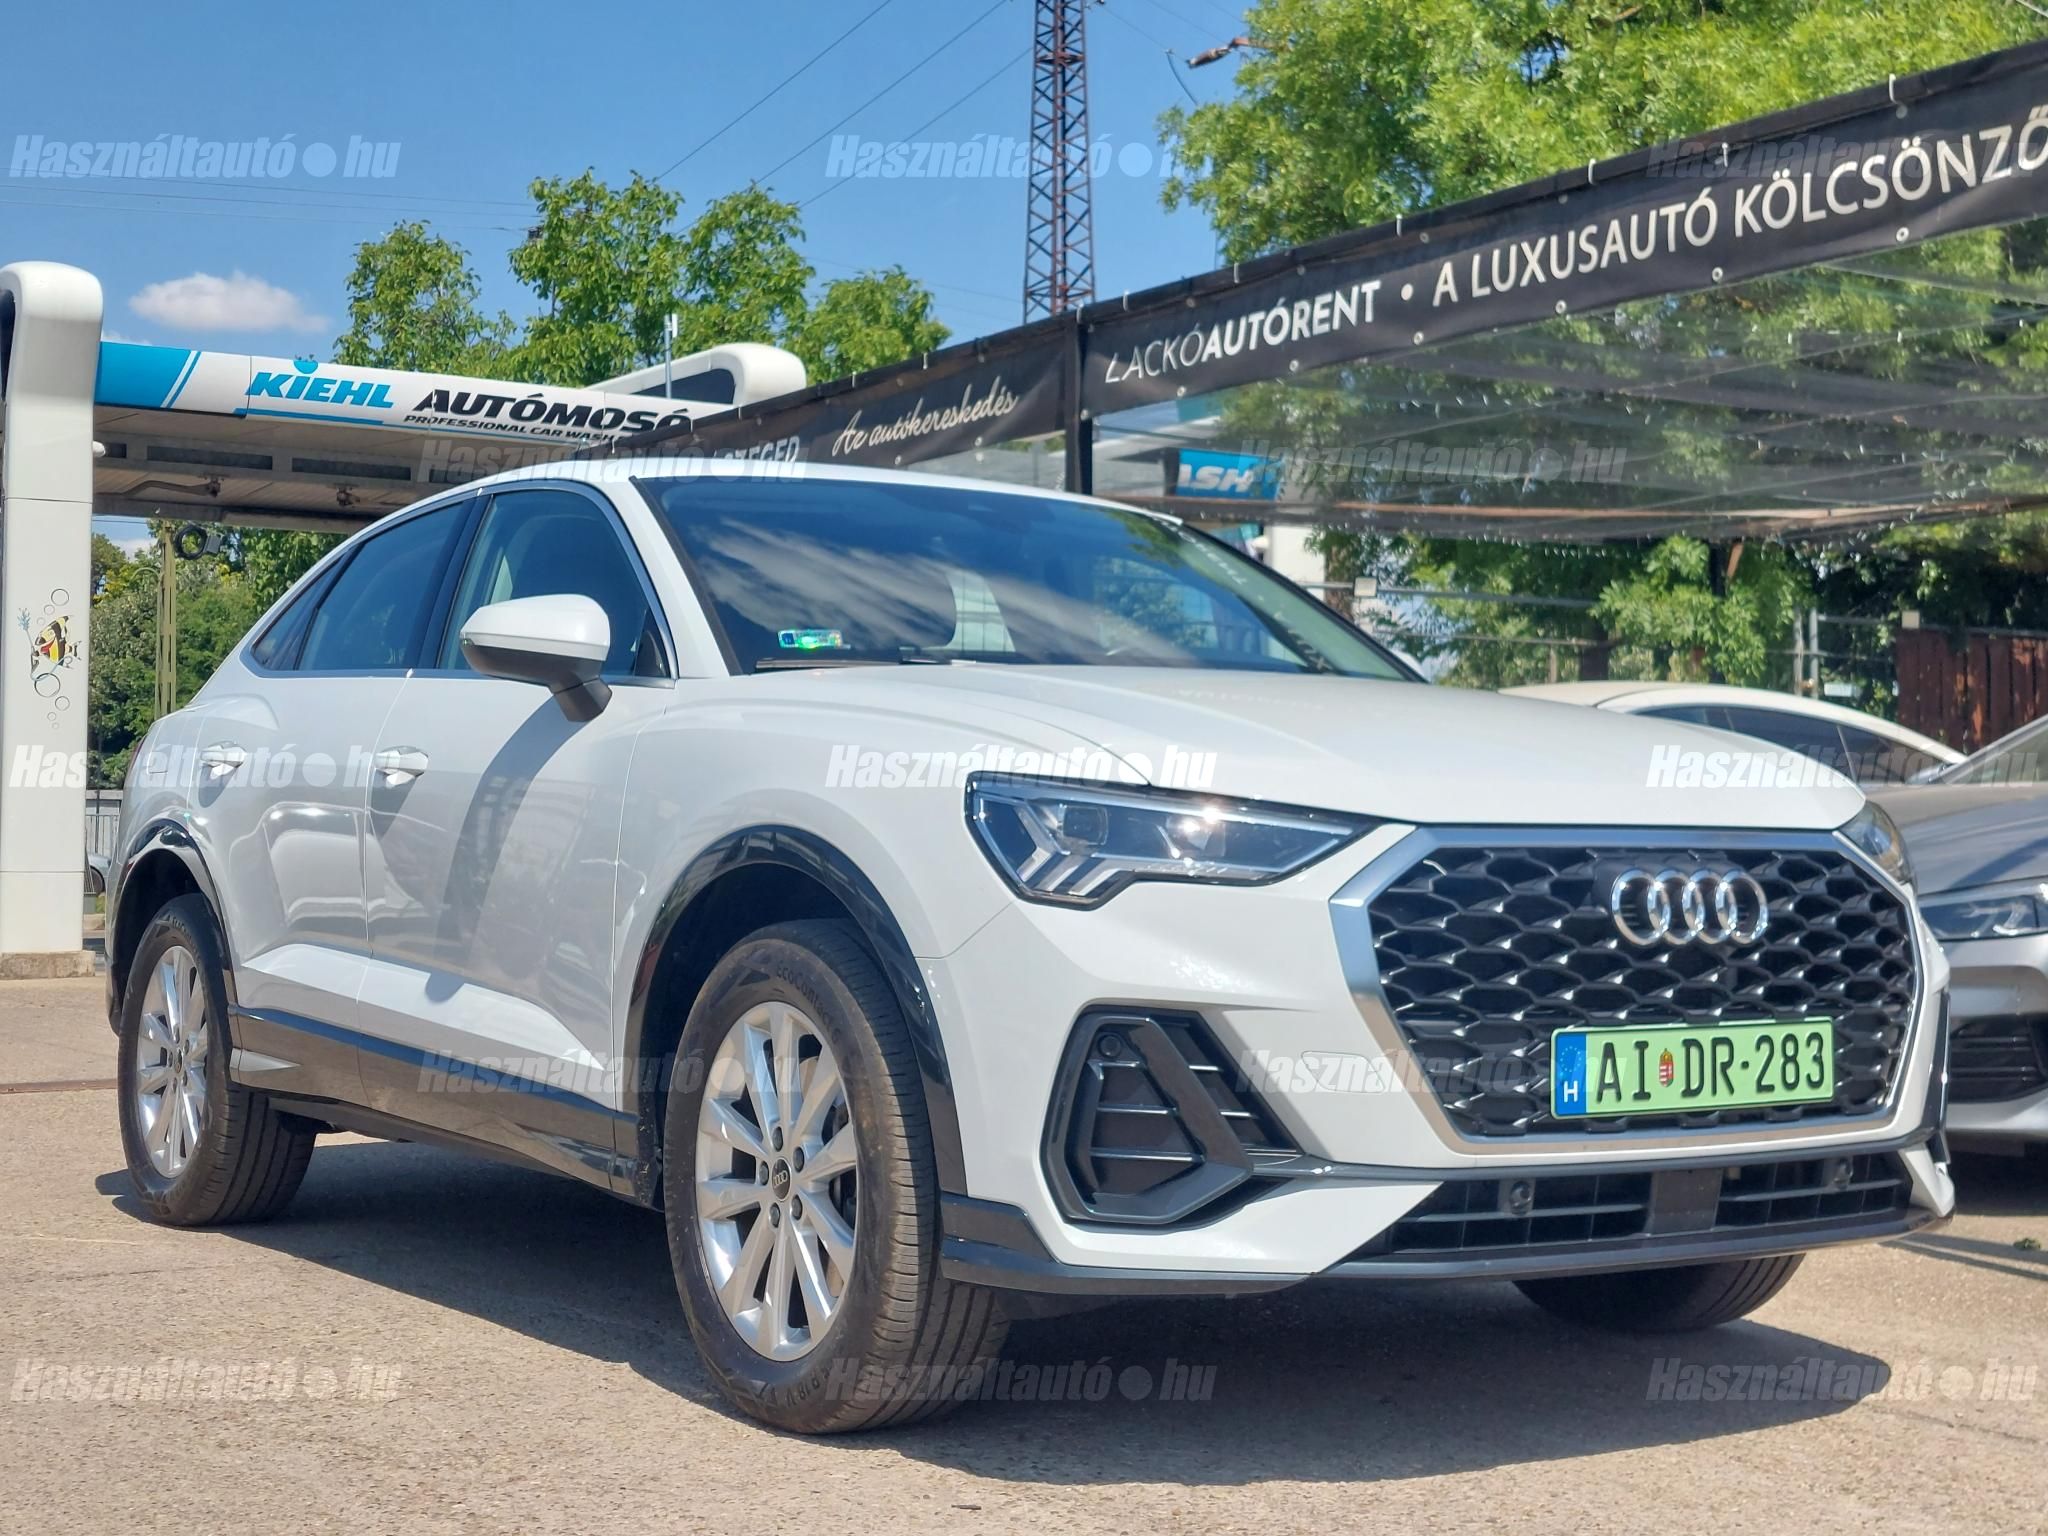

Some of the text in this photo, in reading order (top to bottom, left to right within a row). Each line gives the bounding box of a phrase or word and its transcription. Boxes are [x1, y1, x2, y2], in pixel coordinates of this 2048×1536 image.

[1432, 261, 1458, 306] A
[1471, 188, 1718, 298] LUXUSAUTÓ
[403, 415, 527, 434] PROFESSIONAL
[530, 427, 563, 437] CAR
[566, 431, 616, 442] WASH
[413, 388, 692, 432] AUTÓMOSÓ
[868, 376, 1020, 446] autókereskedés
[1563, 1081, 1578, 1103] H
[1596, 1040, 1652, 1104] AI
